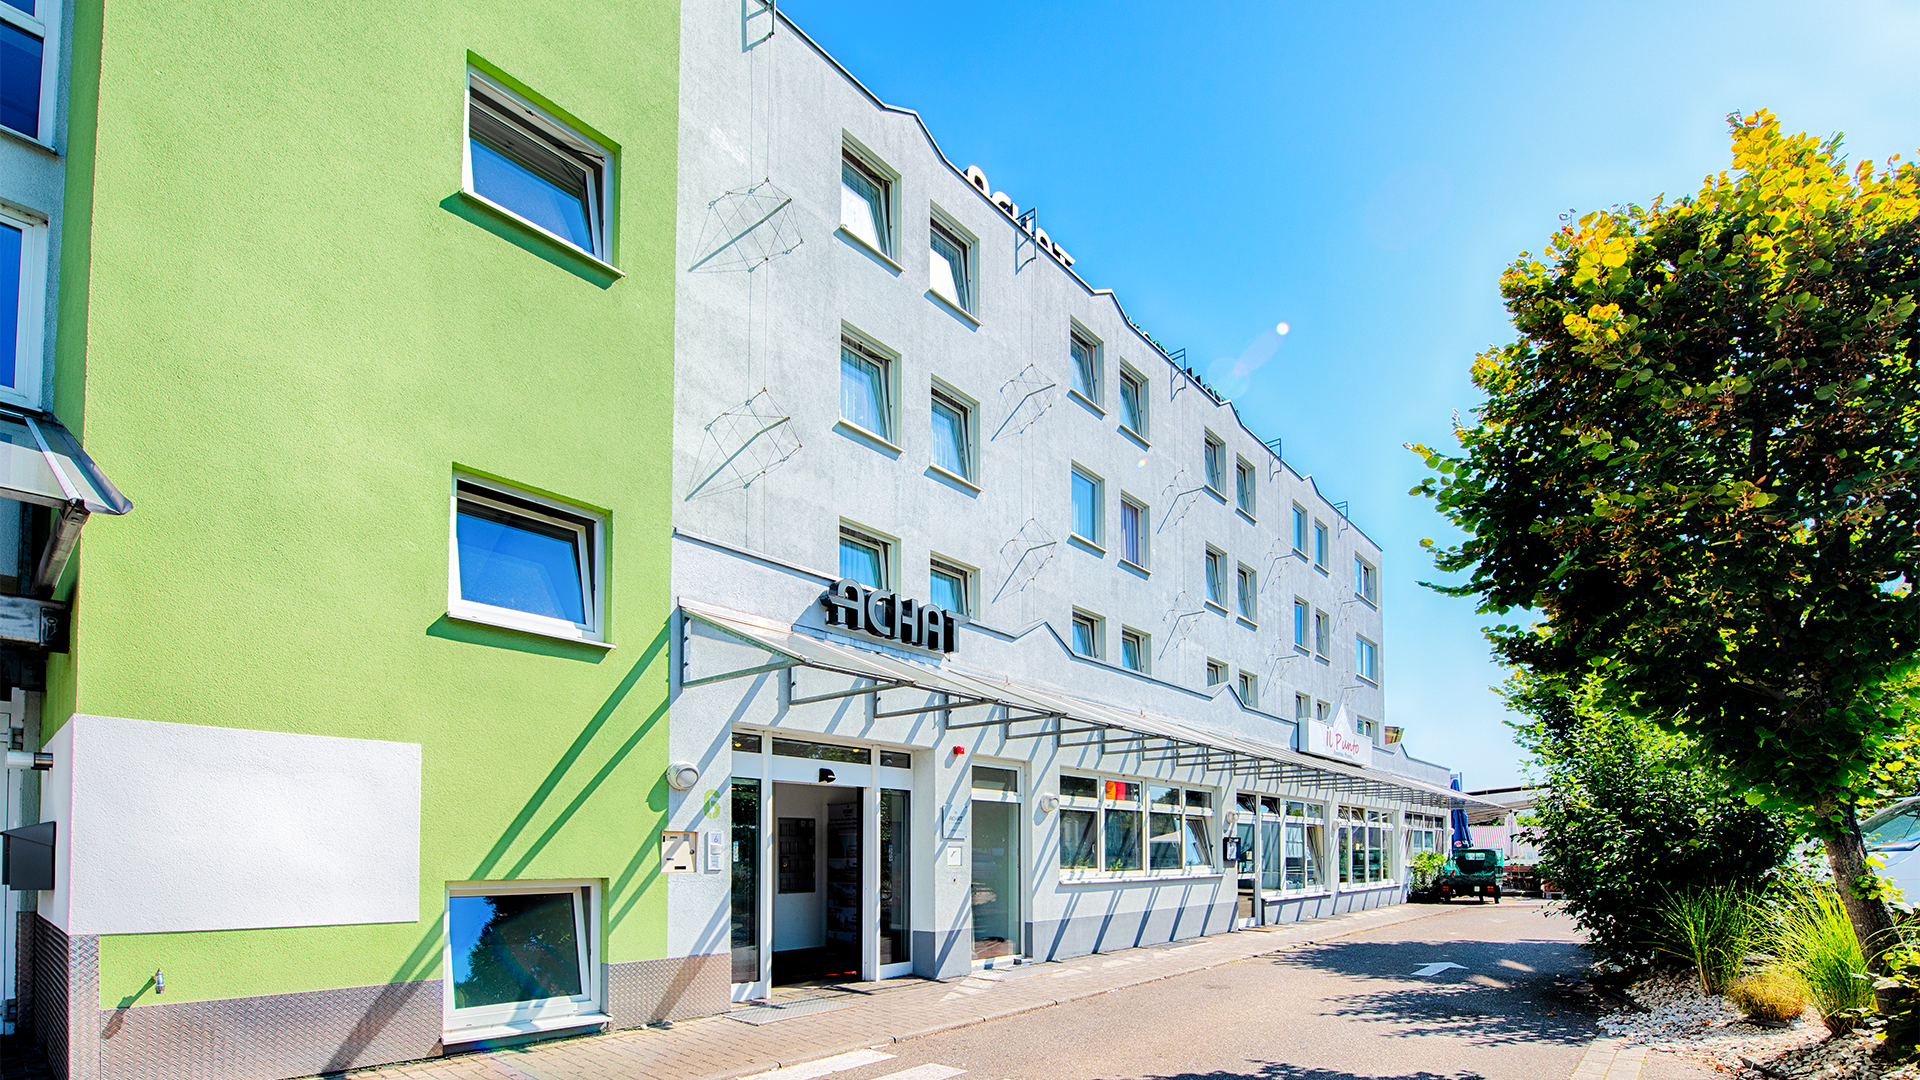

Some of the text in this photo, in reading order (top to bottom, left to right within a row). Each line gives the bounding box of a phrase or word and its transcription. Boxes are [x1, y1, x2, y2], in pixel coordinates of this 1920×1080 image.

[824, 578, 972, 654] ACHAT
[1335, 733, 1360, 755] Punto
[703, 789, 721, 819] 6
